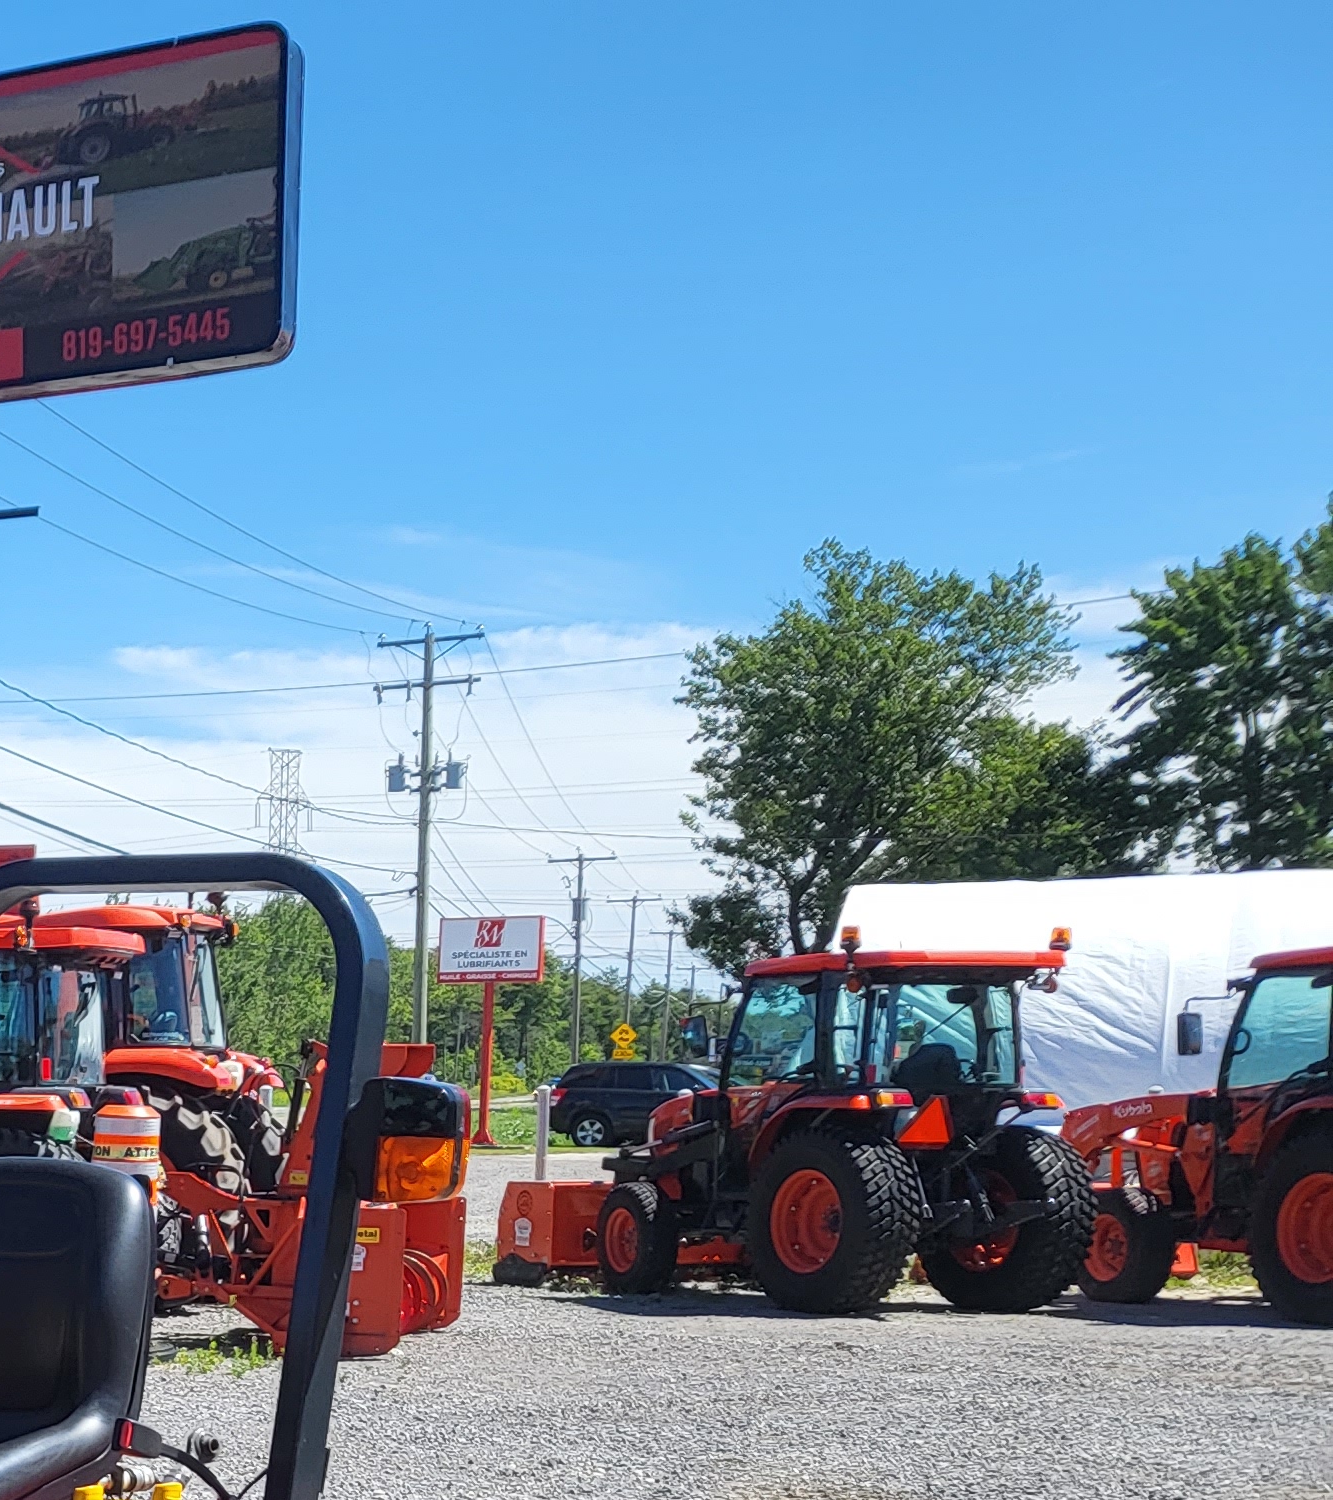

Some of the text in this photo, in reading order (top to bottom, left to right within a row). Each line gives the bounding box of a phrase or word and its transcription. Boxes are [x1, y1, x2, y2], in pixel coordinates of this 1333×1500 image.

[61, 306, 231, 362] 819-697-5445
[451, 949, 528, 960] SPÉCIALISTE EN
[457, 959, 521, 969] LUBRIFIANTS
[1114, 1100, 1153, 1119] Kubota
